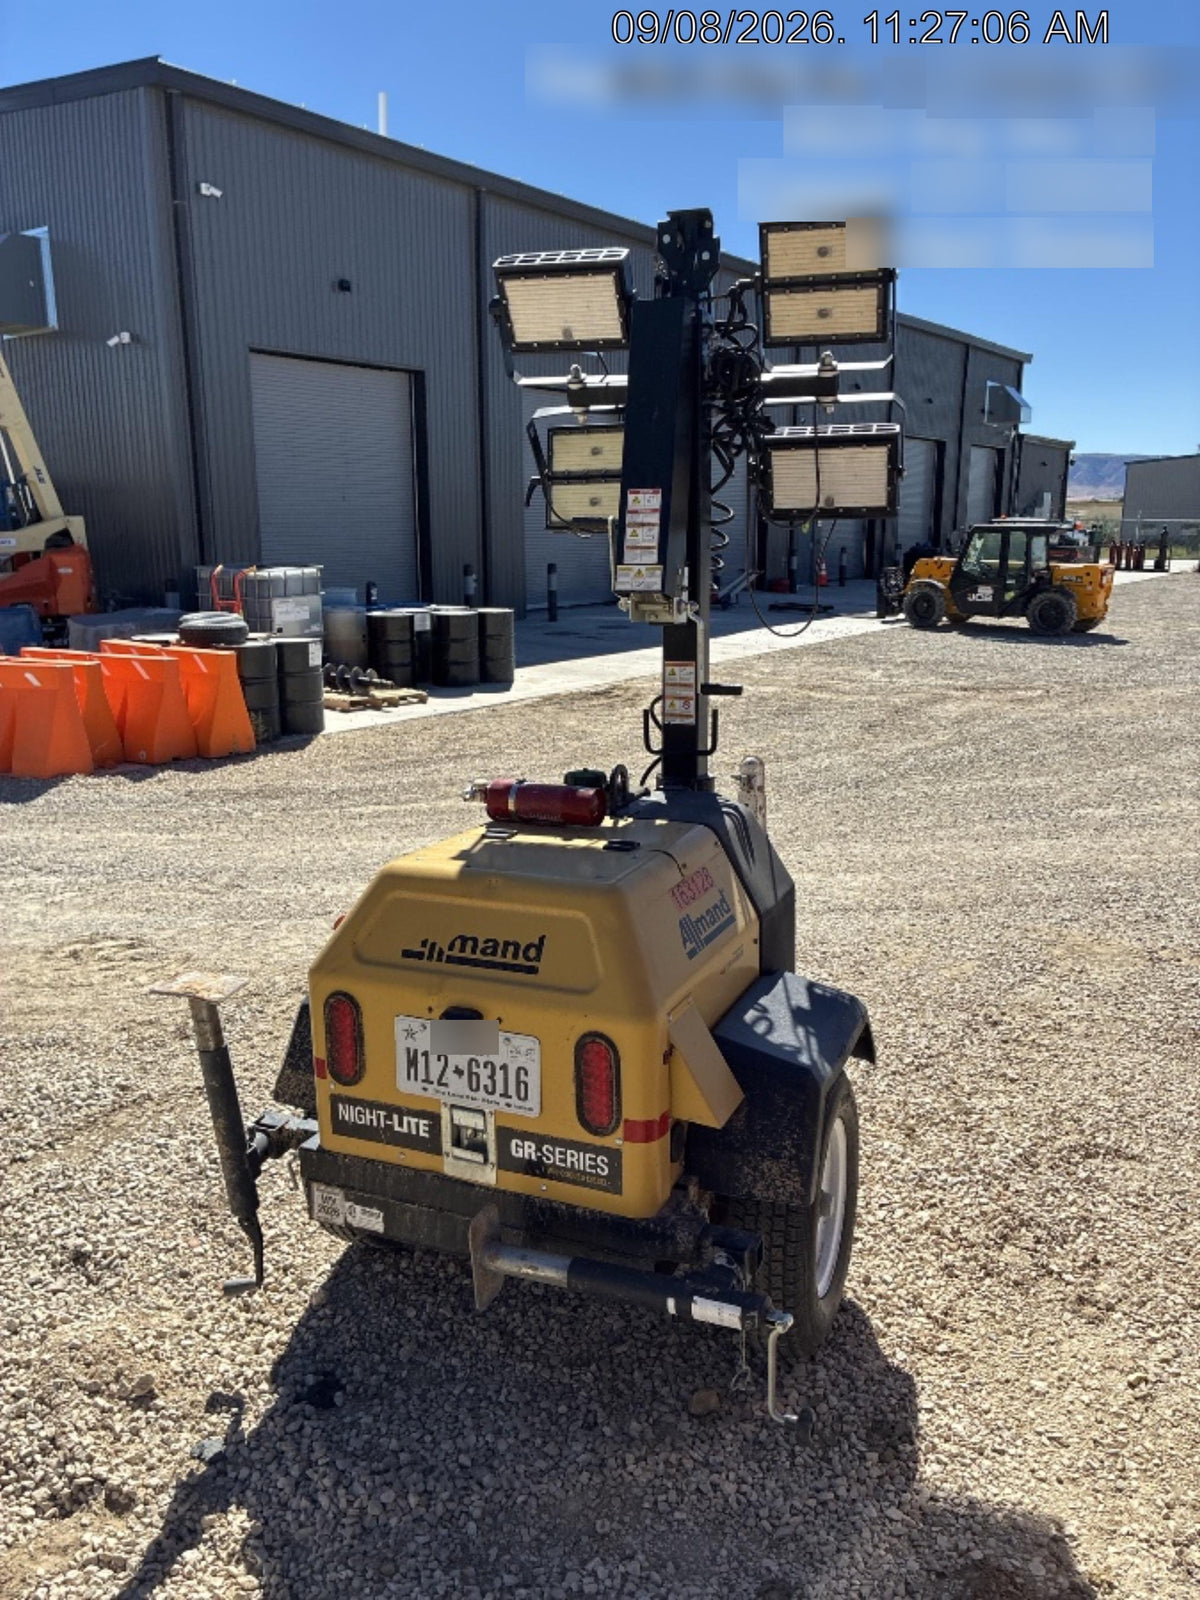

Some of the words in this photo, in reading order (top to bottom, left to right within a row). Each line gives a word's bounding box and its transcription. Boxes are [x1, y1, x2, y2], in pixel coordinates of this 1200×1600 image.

[679, 888, 732, 953] Allmand
[467, 1057, 529, 1101] 6316
[338, 1103, 430, 1139] NIGHT-LITE
[510, 1138, 609, 1176] GR-SERIES
